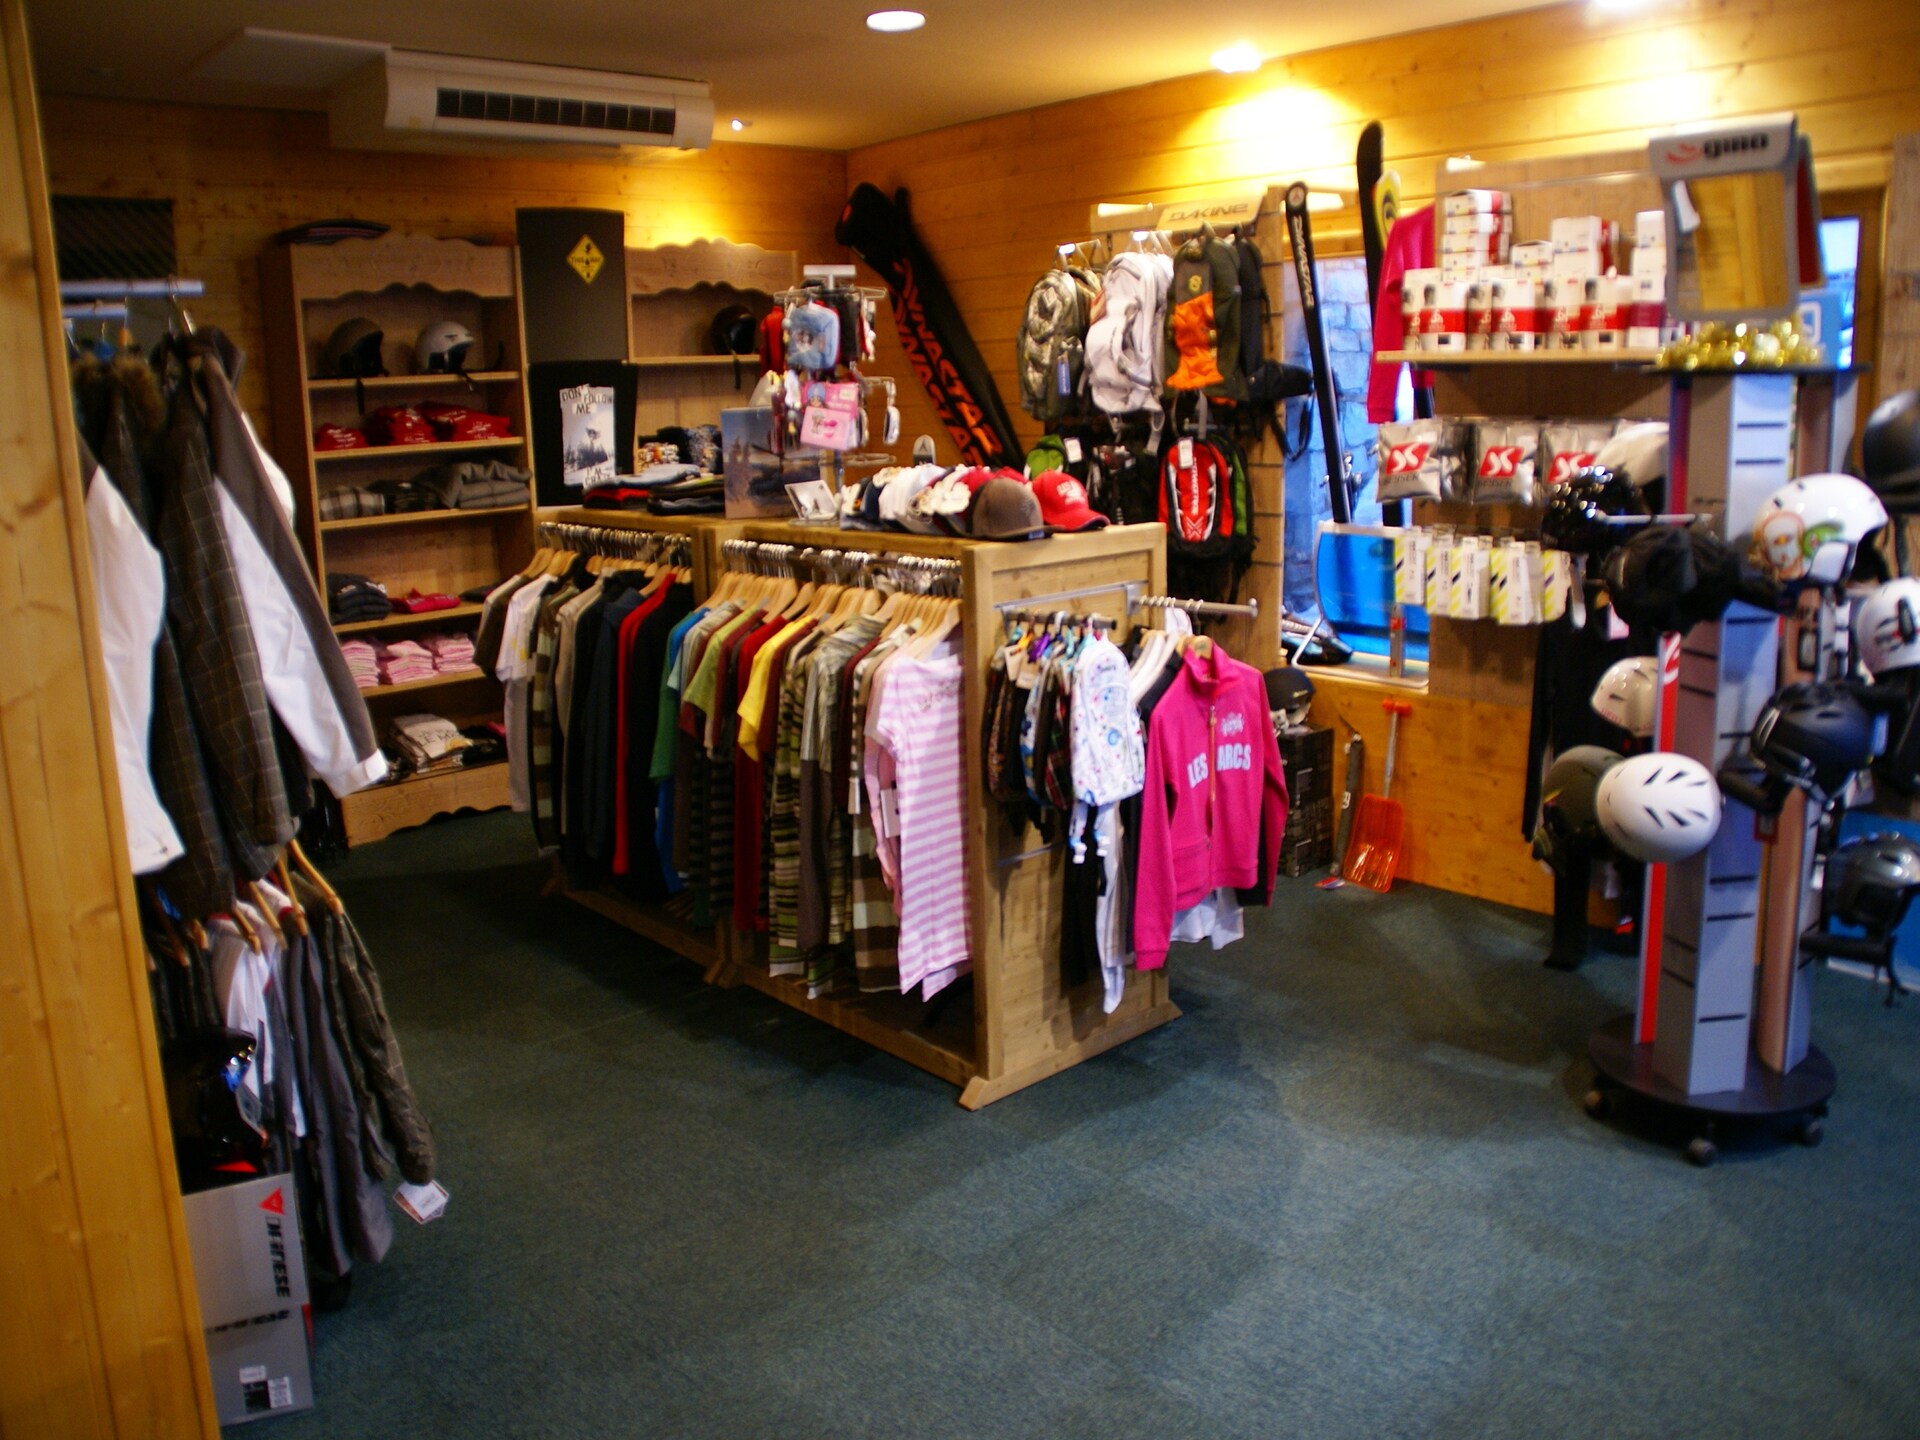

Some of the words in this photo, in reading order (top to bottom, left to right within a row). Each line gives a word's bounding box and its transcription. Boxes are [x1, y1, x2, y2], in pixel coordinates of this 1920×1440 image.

[1167, 203, 1249, 222] DAKINE
[893, 258, 1003, 457] DYNASTAR
[576, 404, 592, 414] ME
[1187, 752, 1209, 789] LES
[1216, 743, 1252, 771] ARCS
